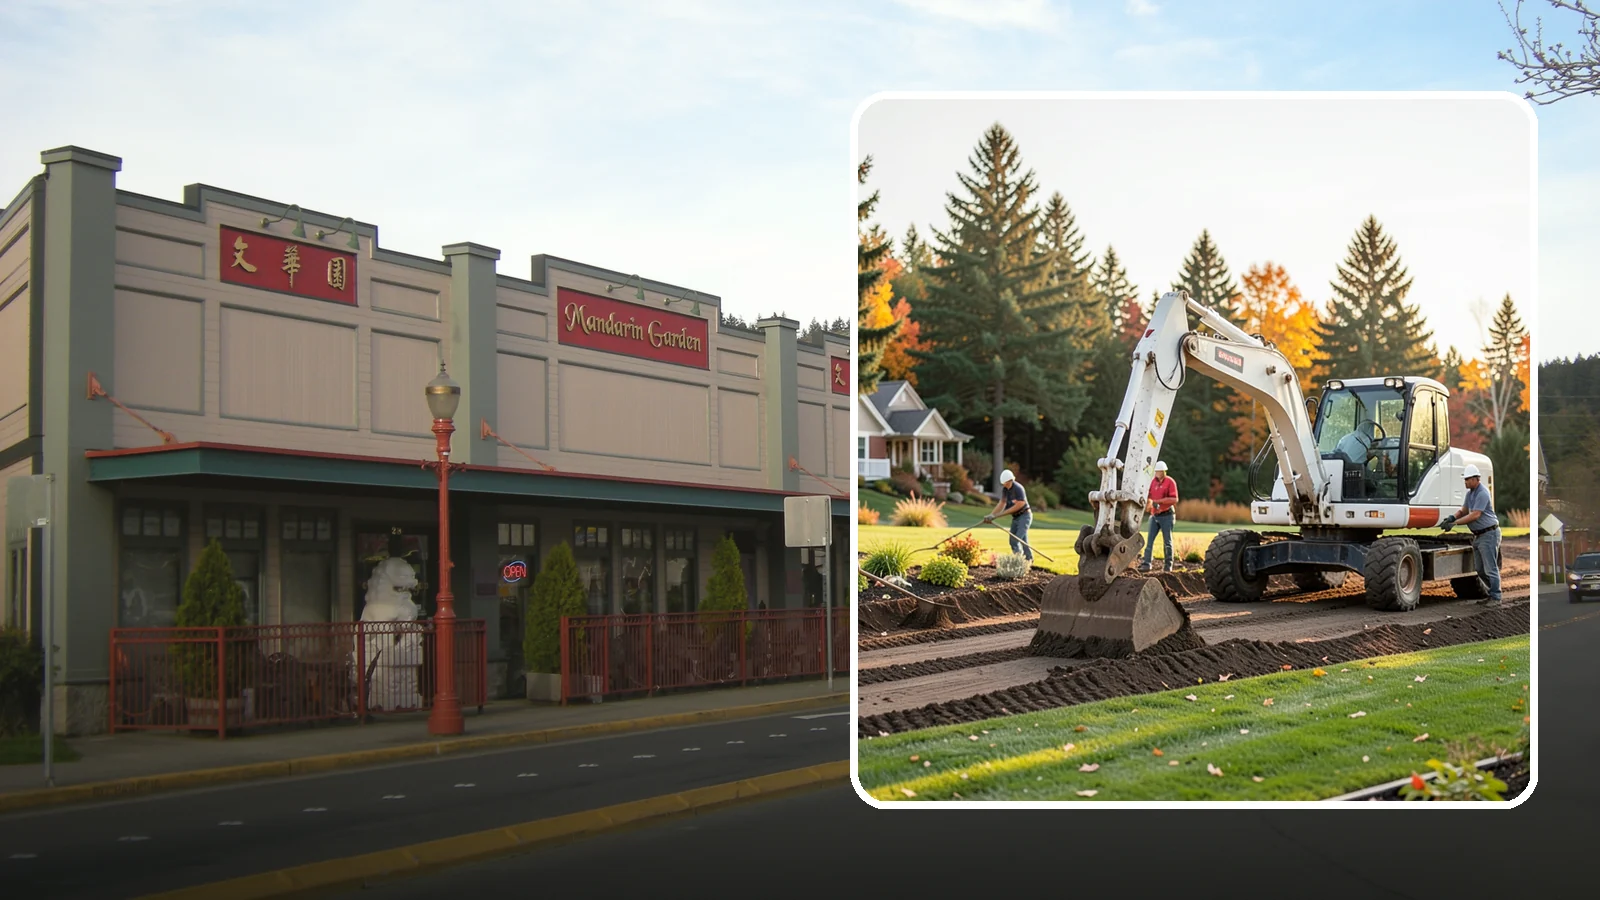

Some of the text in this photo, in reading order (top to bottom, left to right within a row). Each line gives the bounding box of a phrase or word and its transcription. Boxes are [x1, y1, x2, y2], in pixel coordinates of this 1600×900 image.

[231, 235, 346, 291] 文華園
[564, 302, 702, 352] Mandarin Garden
[503, 565, 527, 578] OPEN
